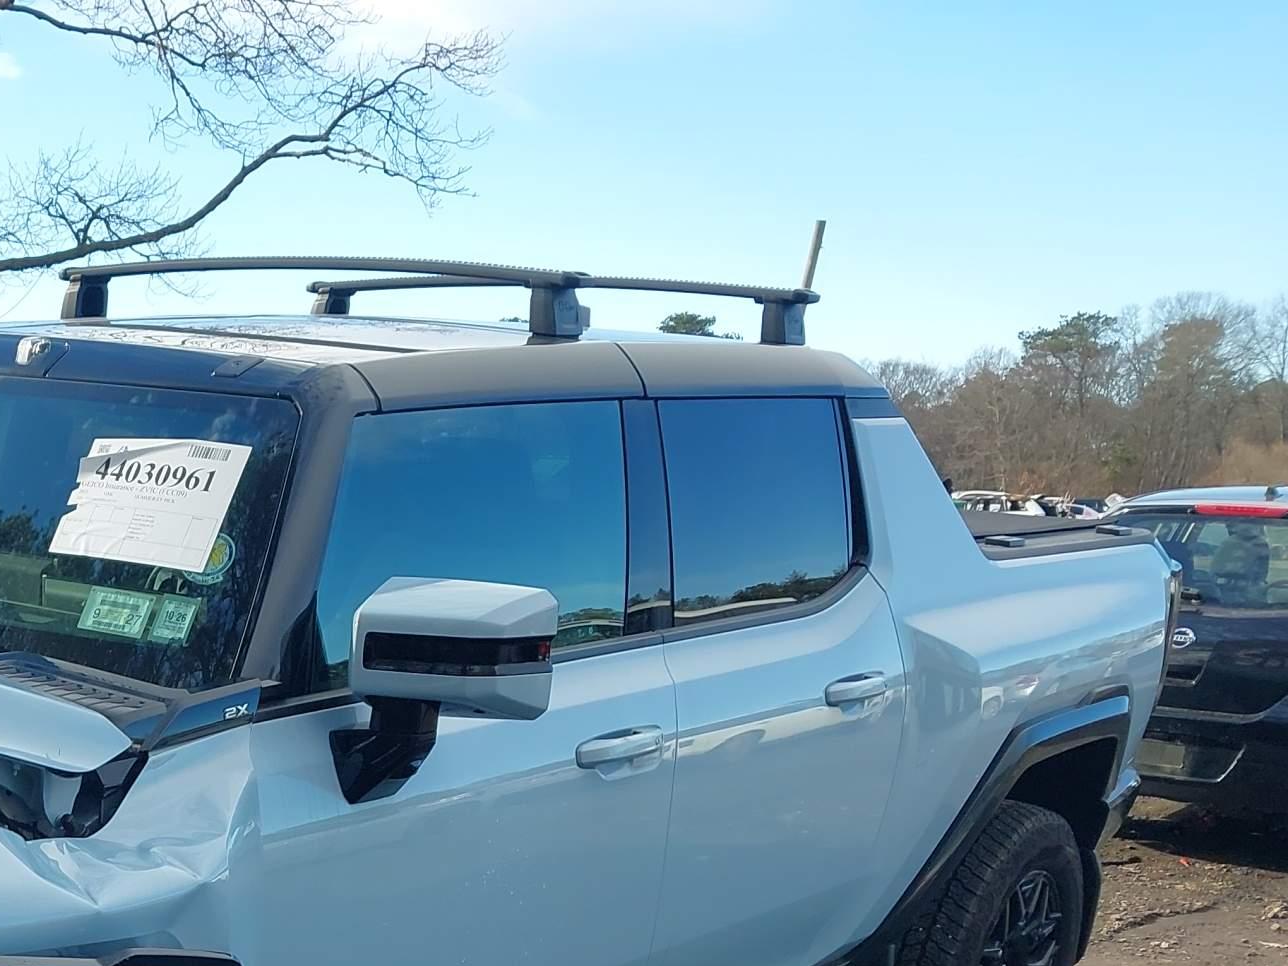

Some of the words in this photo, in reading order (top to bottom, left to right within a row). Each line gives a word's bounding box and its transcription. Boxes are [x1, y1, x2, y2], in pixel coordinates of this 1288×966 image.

[94, 456, 217, 493] 44030961
[81, 480, 106, 490] GEICO
[105, 483, 135, 493] Insurance
[92, 607, 102, 619] 9
[126, 612, 143, 626] 27
[224, 703, 249, 719] 2X
